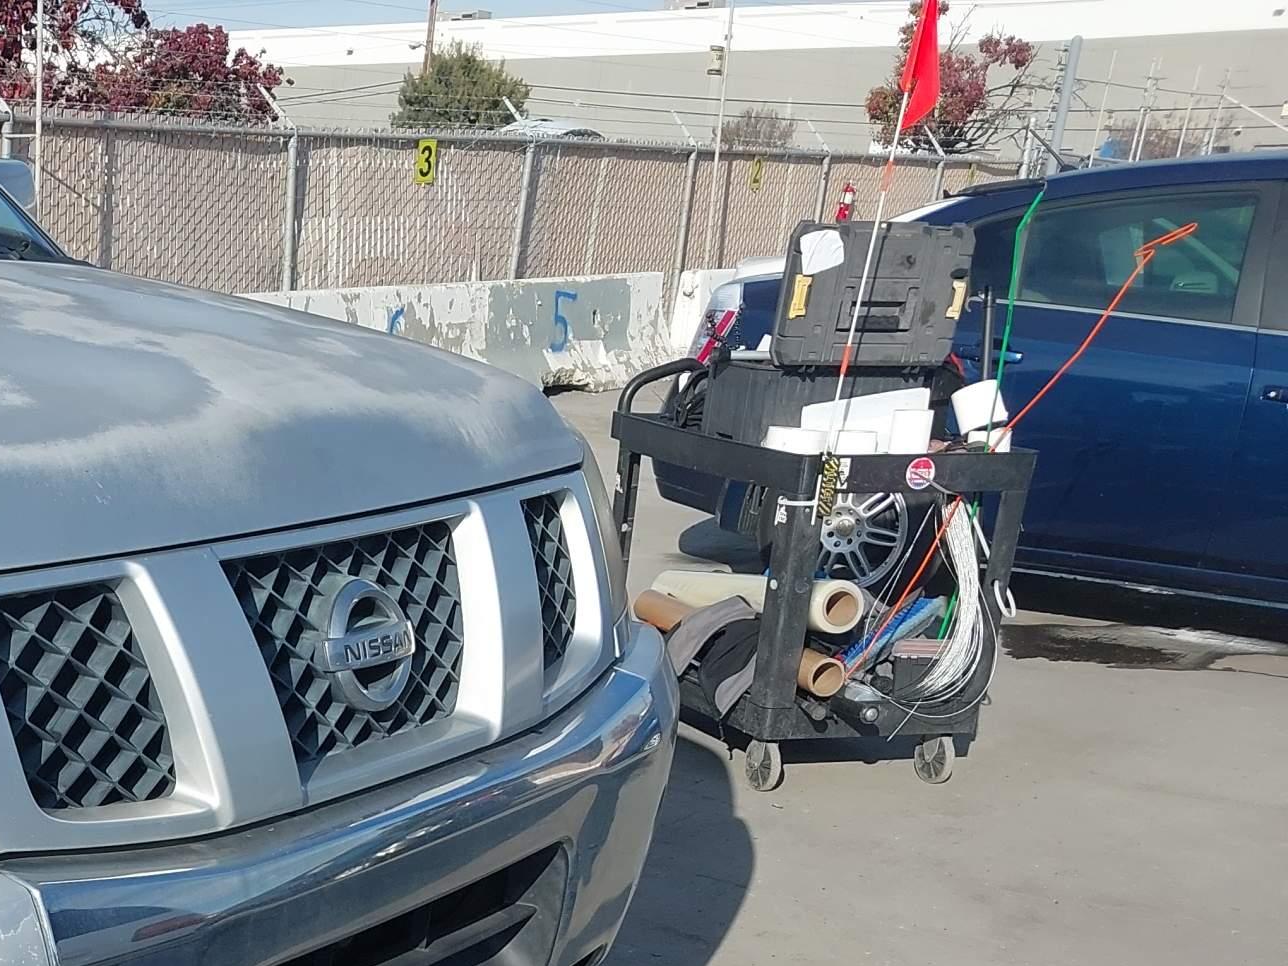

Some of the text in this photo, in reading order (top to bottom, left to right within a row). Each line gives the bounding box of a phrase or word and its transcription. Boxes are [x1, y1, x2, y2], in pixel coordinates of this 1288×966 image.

[419, 145, 433, 178] 3
[752, 158, 762, 184] 2
[550, 289, 578, 353] 5
[343, 630, 412, 663] NISSAN
